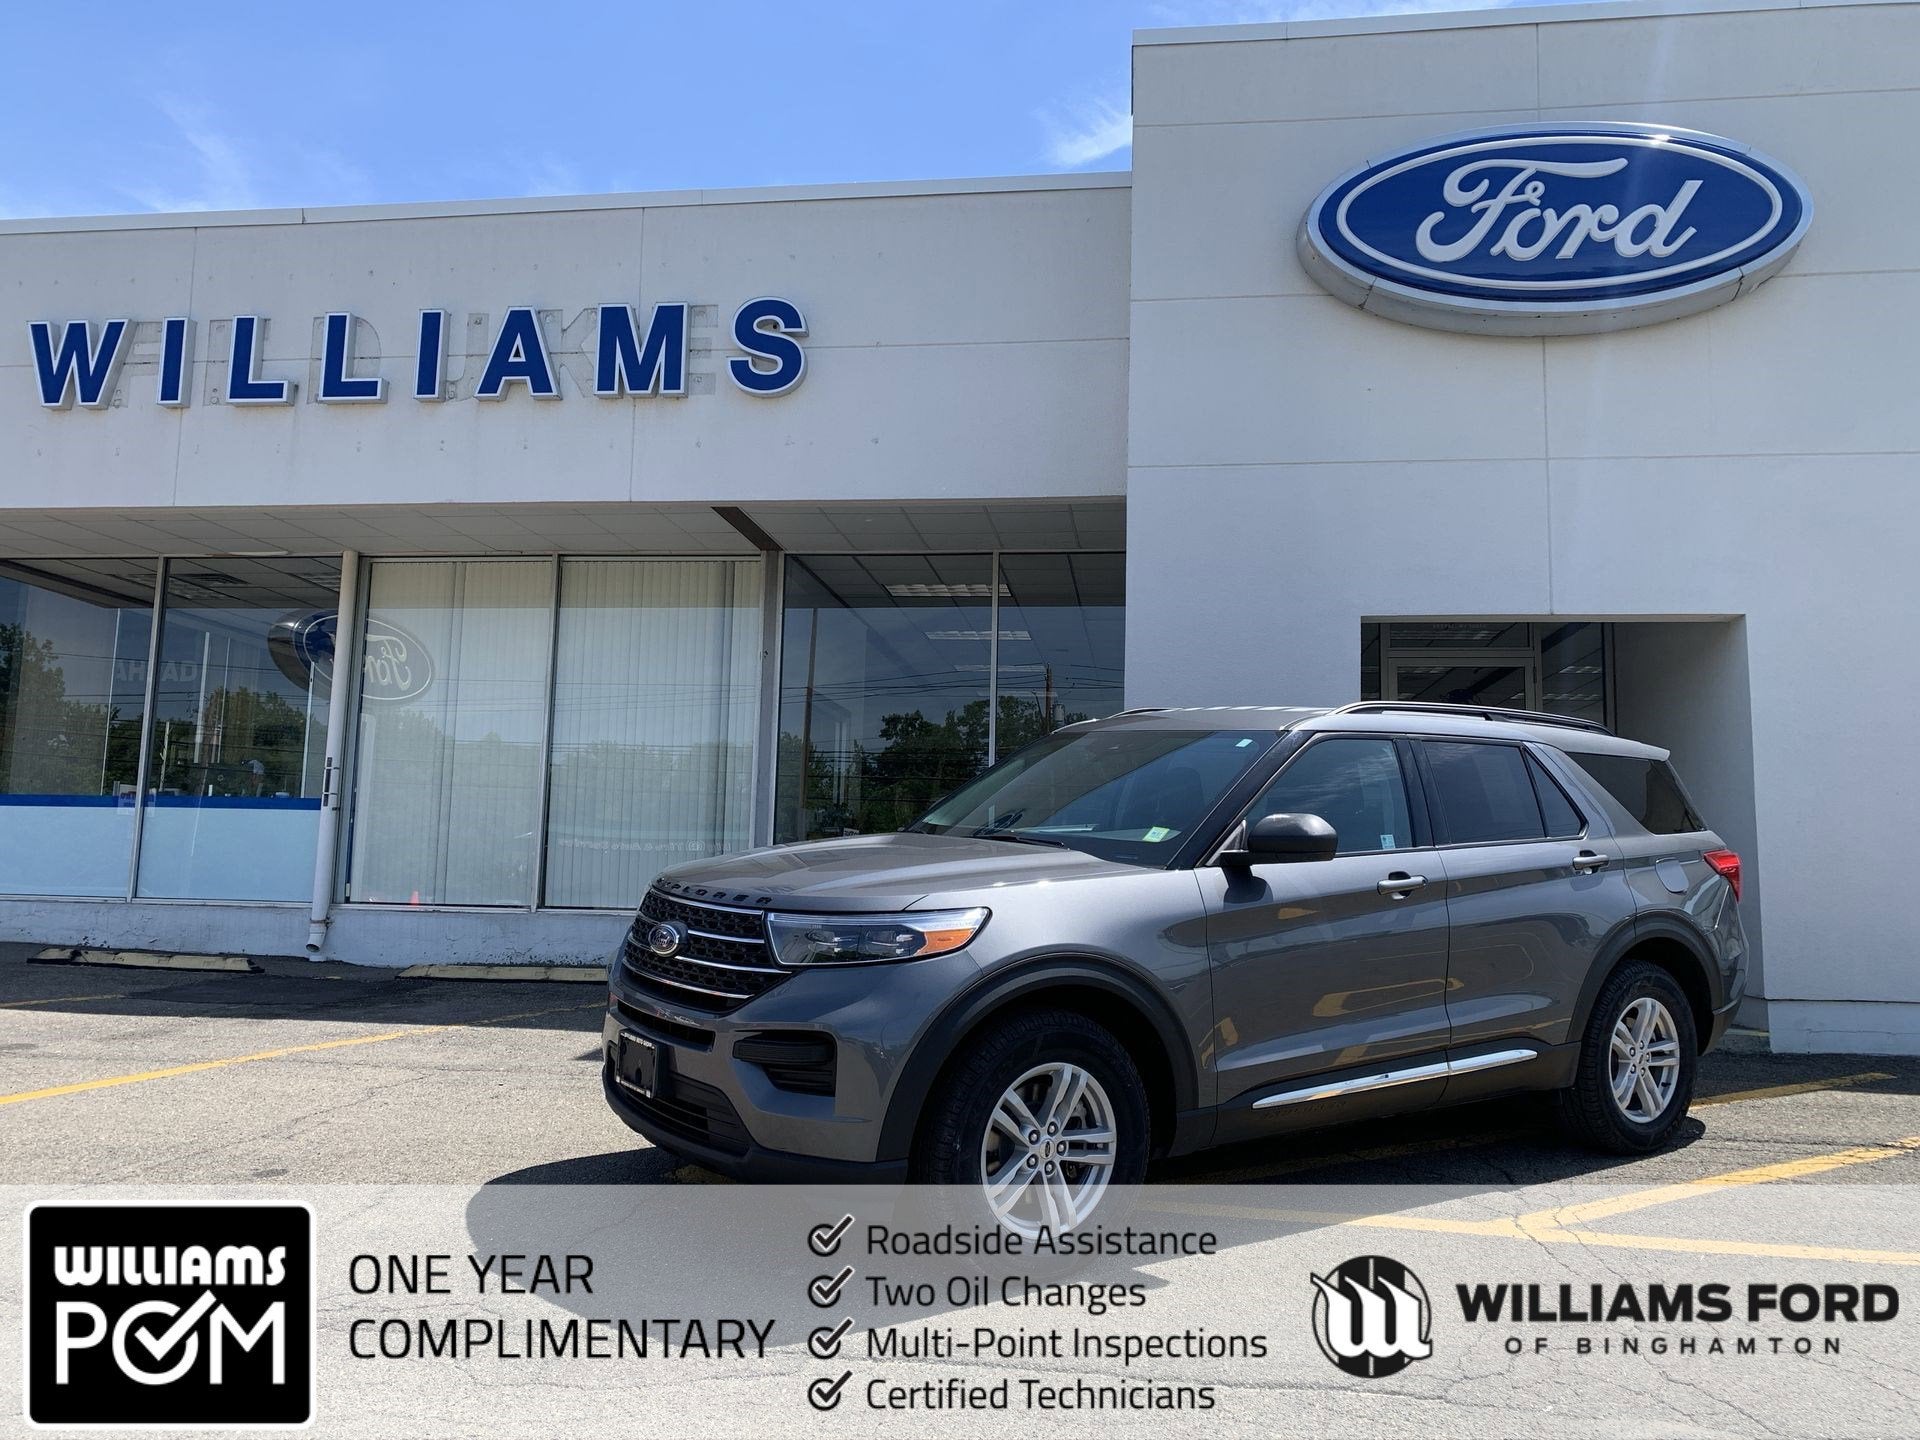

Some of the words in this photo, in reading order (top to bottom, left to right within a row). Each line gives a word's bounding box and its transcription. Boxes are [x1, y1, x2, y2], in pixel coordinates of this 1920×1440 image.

[1414, 157, 1704, 263] Ford
[27, 296, 808, 409] WILLIAMS
[115, 660, 198, 682] AHAD
